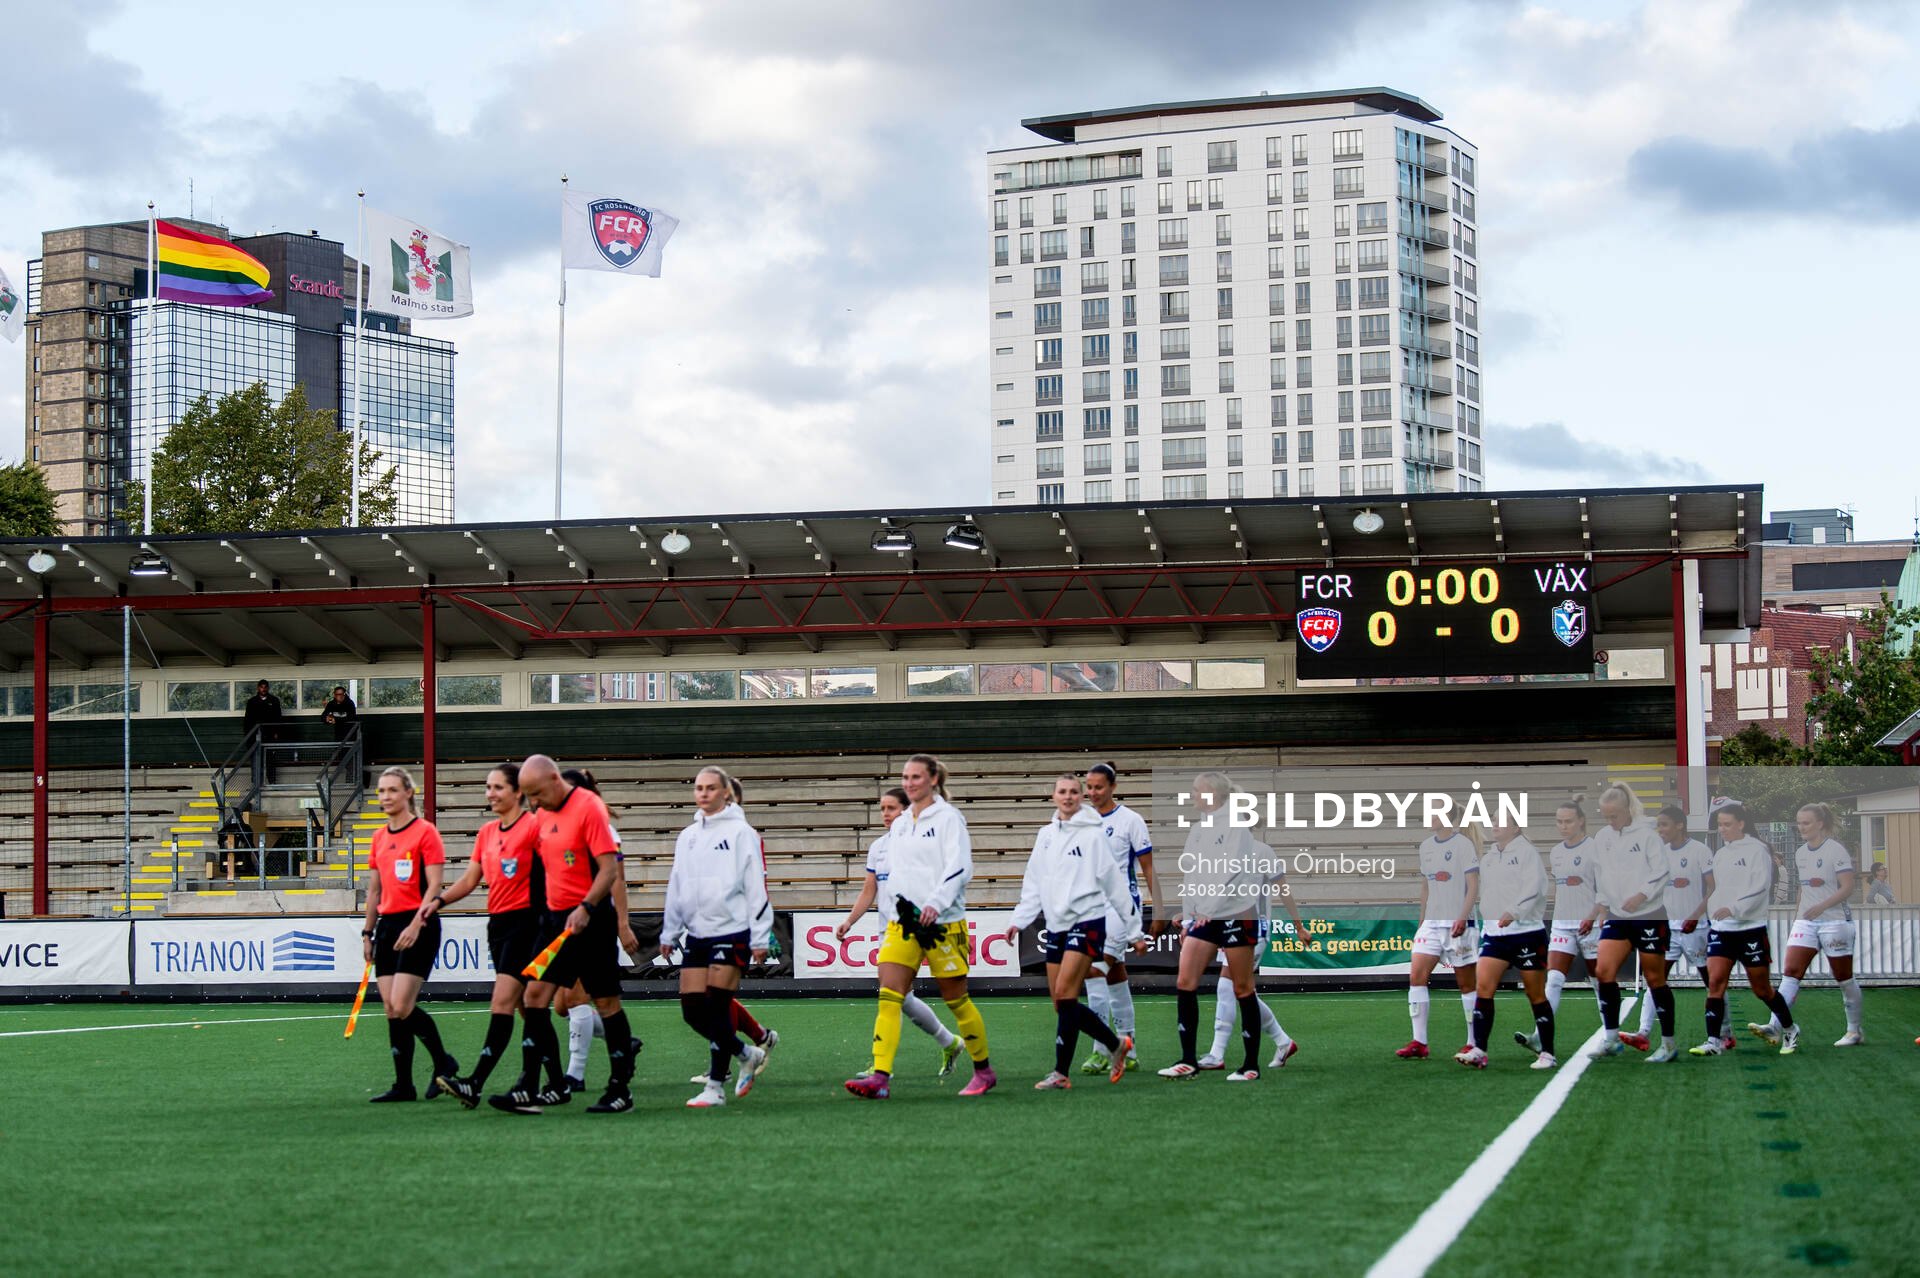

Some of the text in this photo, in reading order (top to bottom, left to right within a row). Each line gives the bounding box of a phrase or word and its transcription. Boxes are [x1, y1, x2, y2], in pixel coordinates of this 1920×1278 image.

[599, 214, 643, 234] FCR
[289, 273, 344, 300] Scandic
[391, 294, 454, 313] Malmö stad
[1301, 574, 1353, 599] FCR
[1386, 567, 1500, 606] 0:00
[1533, 562, 1588, 593] VÄX
[1303, 619, 1335, 630] FCR
[1368, 610, 1397, 647] 0
[1490, 607, 1520, 644] 0
[1309, 919, 1335, 934] för
[0, 943, 59, 968] VICE
[150, 939, 265, 973] TRIANON
[806, 921, 1008, 967] Scic
[1327, 936, 1414, 955] generatio
